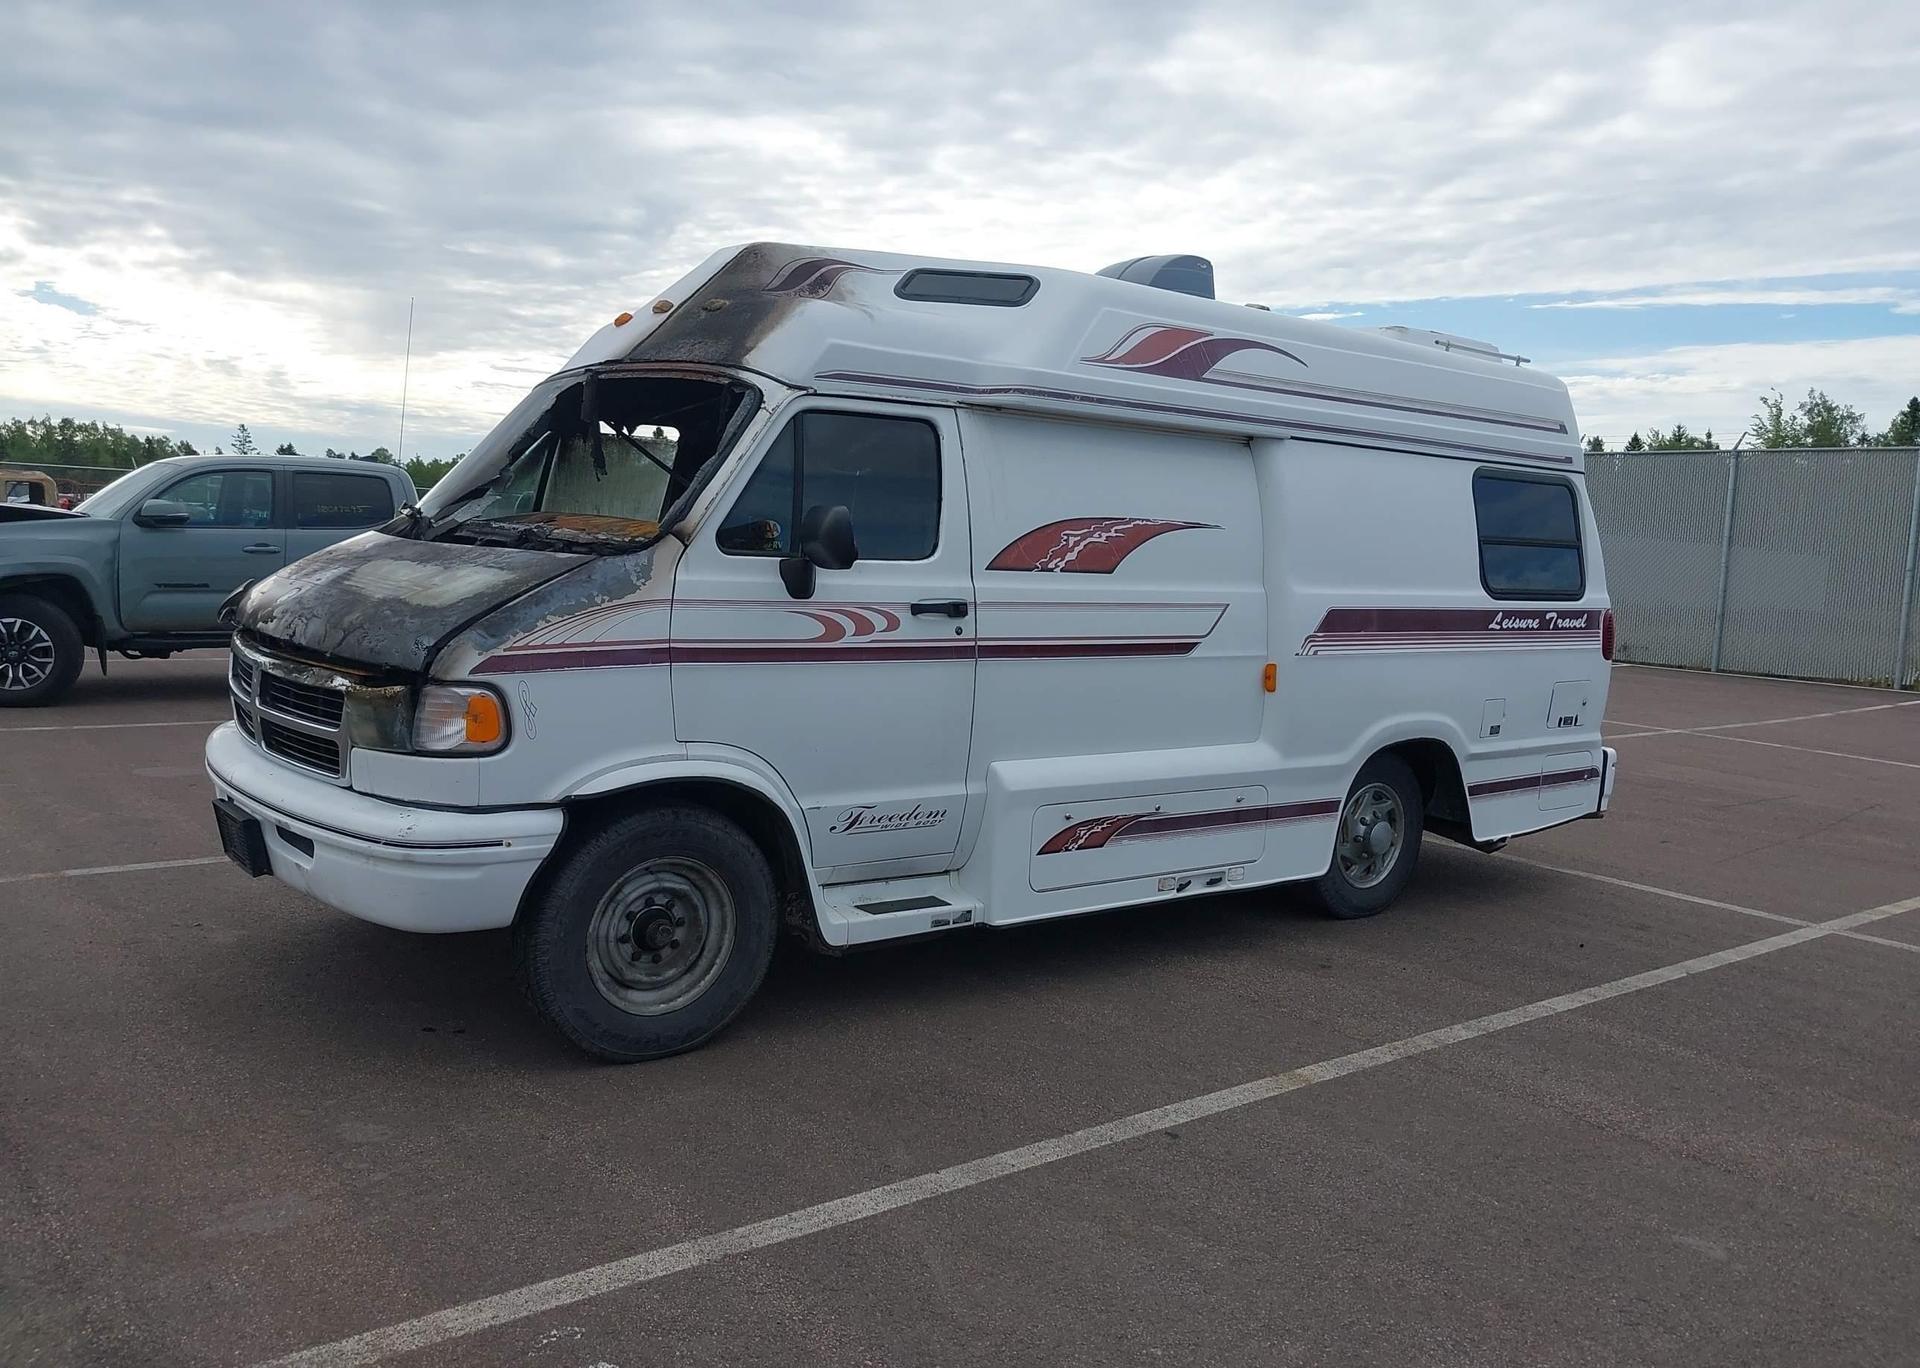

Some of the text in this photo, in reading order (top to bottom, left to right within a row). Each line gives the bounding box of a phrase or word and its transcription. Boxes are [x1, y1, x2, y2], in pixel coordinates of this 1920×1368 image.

[1488, 612, 1588, 630] Leisure Travel
[829, 803, 947, 834] Freedom
